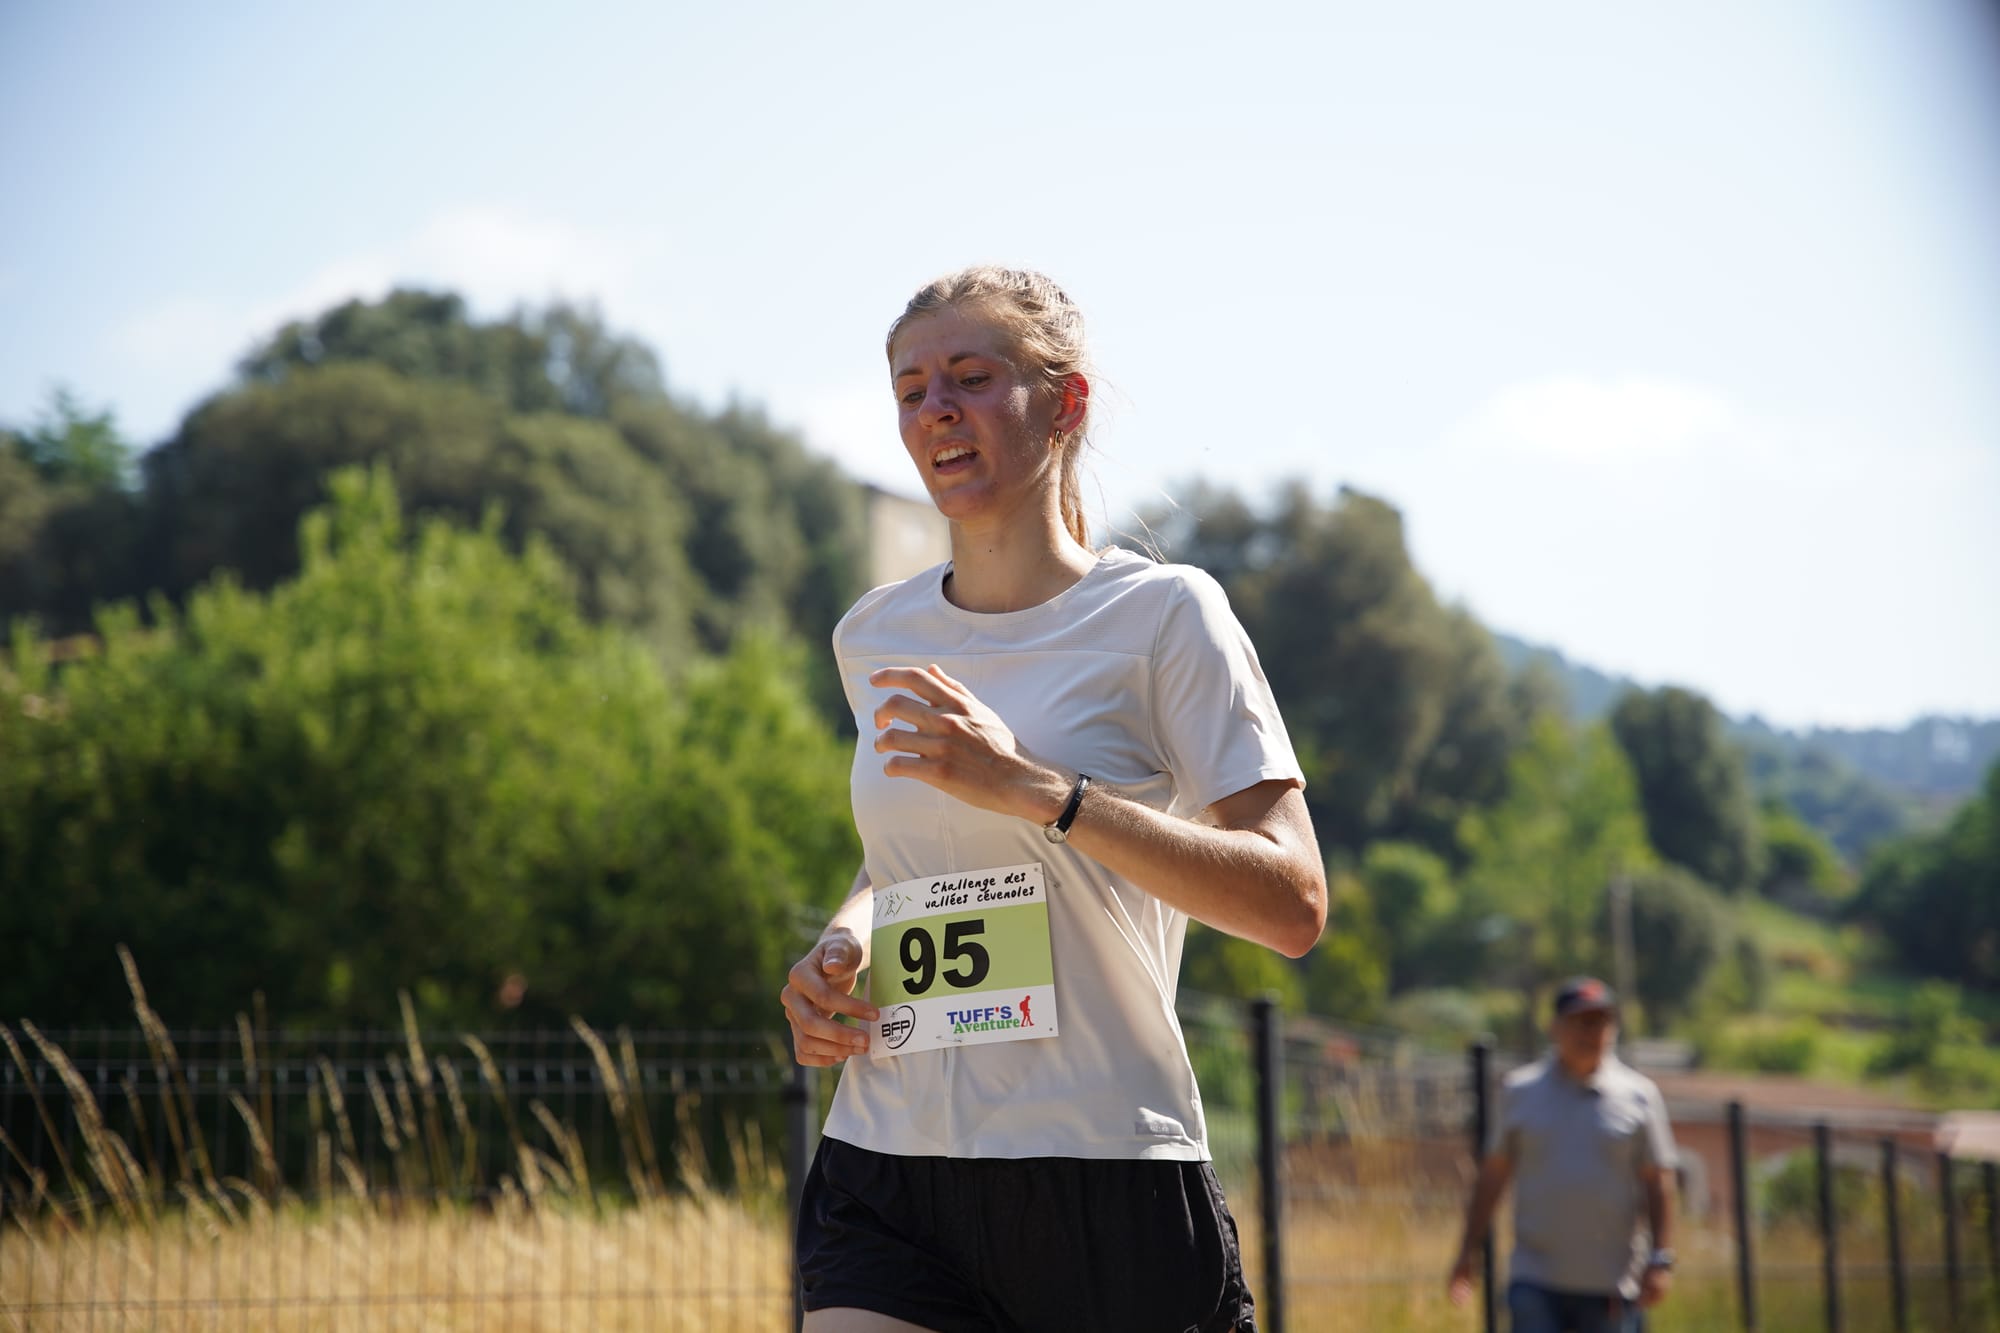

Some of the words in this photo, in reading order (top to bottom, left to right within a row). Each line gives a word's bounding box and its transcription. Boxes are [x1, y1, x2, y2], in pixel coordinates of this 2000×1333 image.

[930, 877, 996, 894] Challenge
[1004, 872, 1026, 883] des
[925, 893, 969, 909] vallées
[977, 886, 1035, 902] cévenoles
[899, 919, 990, 995] 95
[946, 1005, 1012, 1025] TUFF'S
[881, 1020, 910, 1037] BFP
[953, 1018, 1020, 1034] Aventure
